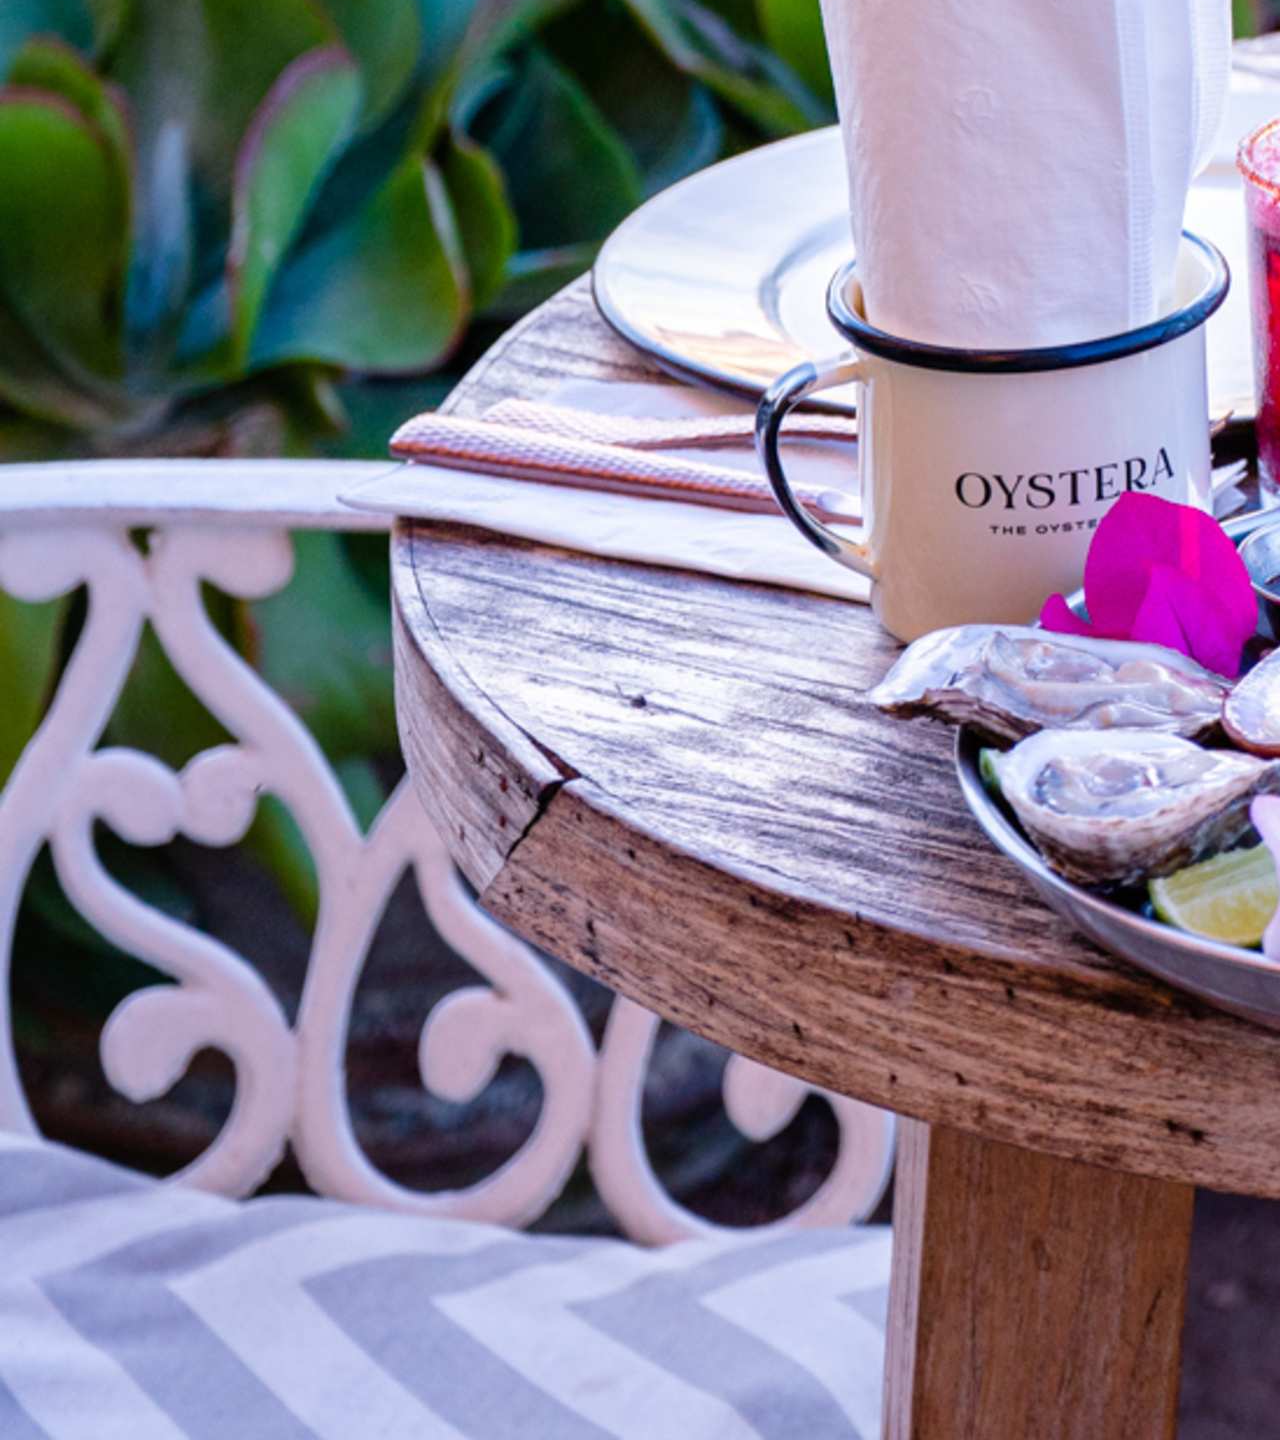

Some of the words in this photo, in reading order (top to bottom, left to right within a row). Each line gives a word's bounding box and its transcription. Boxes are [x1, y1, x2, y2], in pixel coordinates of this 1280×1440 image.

[955, 446, 1175, 509] OYSTERA
[989, 525, 1027, 536] THE
[1035, 518, 1098, 535] OYSTE
